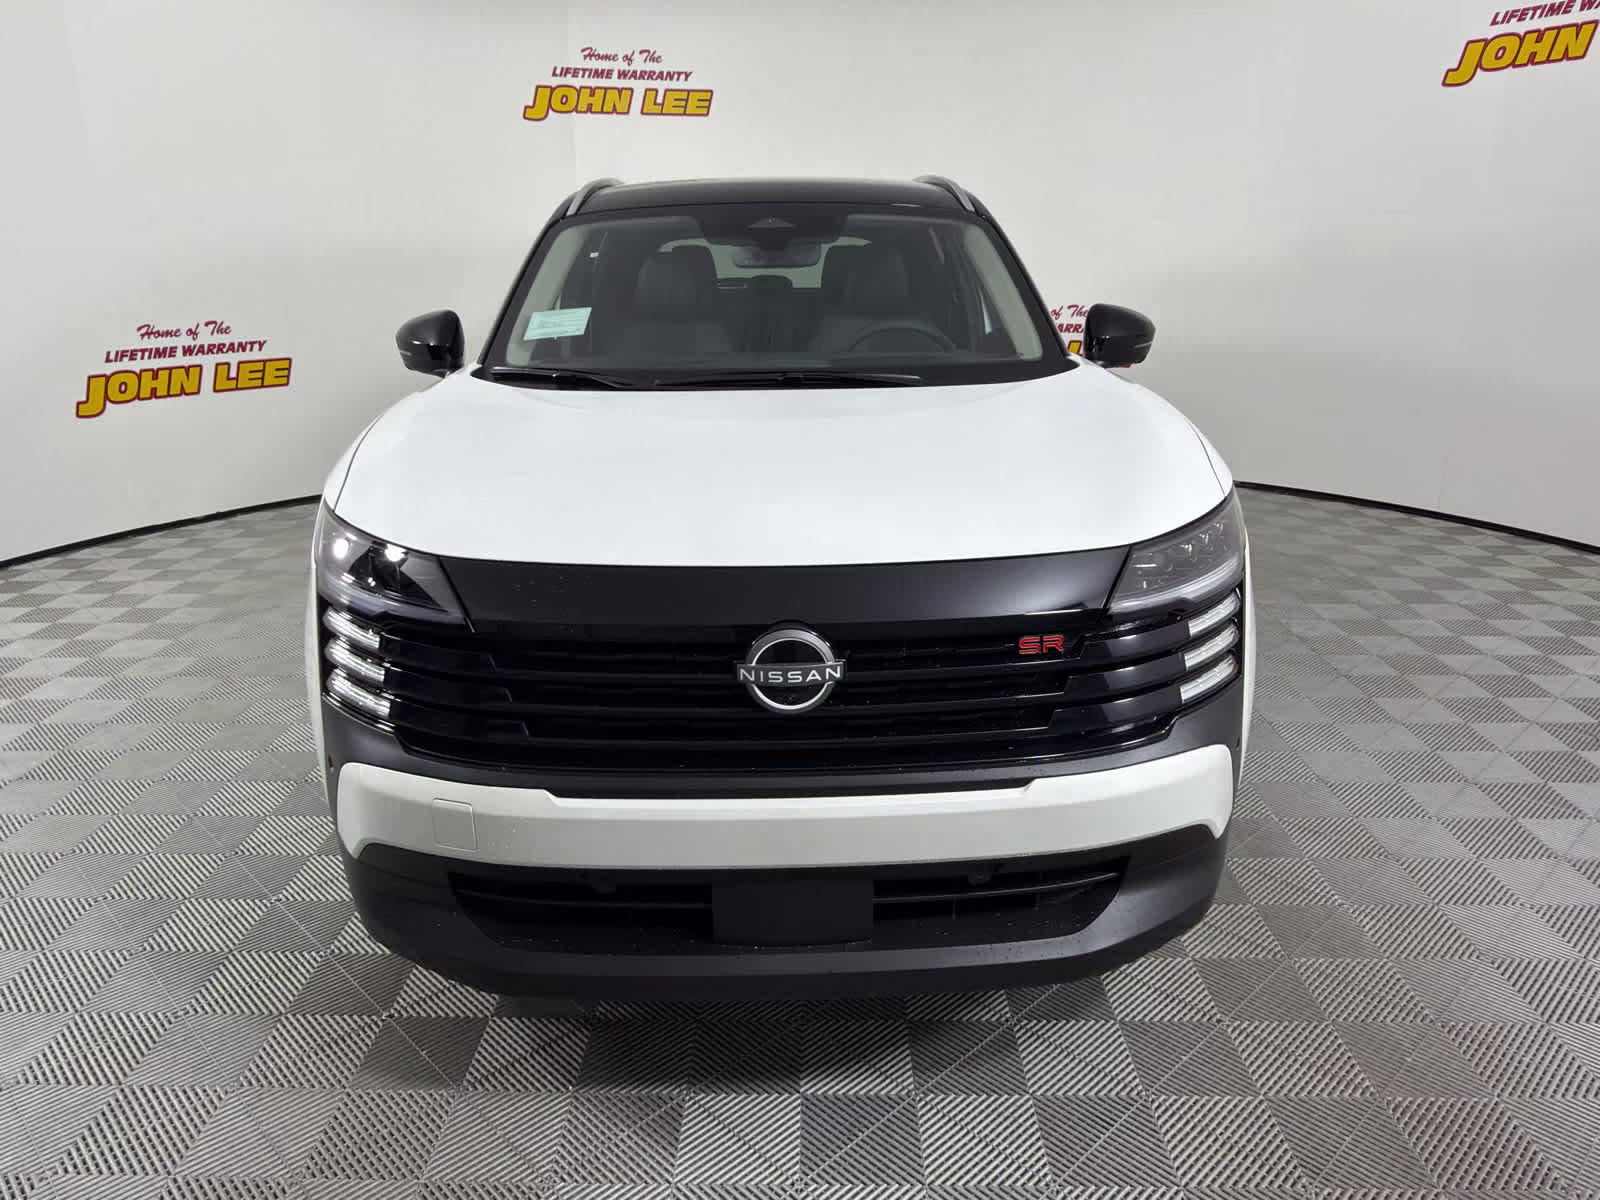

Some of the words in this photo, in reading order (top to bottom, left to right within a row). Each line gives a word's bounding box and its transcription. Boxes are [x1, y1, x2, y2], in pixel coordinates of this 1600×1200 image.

[1490, 0, 1576, 26] LIFETIME
[580, 47, 619, 62] Home
[622, 50, 635, 66] of
[638, 49, 663, 64] The
[1442, 19, 1599, 87] JOHN
[551, 66, 615, 80] LIFETIME
[617, 69, 693, 82] WARRANTY
[523, 85, 634, 121] JOHN
[640, 88, 714, 117] LEE
[1051, 306, 1064, 320] of
[136, 323, 182, 341] Home
[185, 323, 200, 341] of
[204, 320, 232, 336] The
[104, 346, 178, 364] LIFETIME
[181, 340, 267, 357] WARRANTY
[76, 364, 203, 418] JOHN
[212, 357, 292, 393] LEE
[1018, 634, 1065, 655] SR
[740, 665, 841, 683] NISSAN
